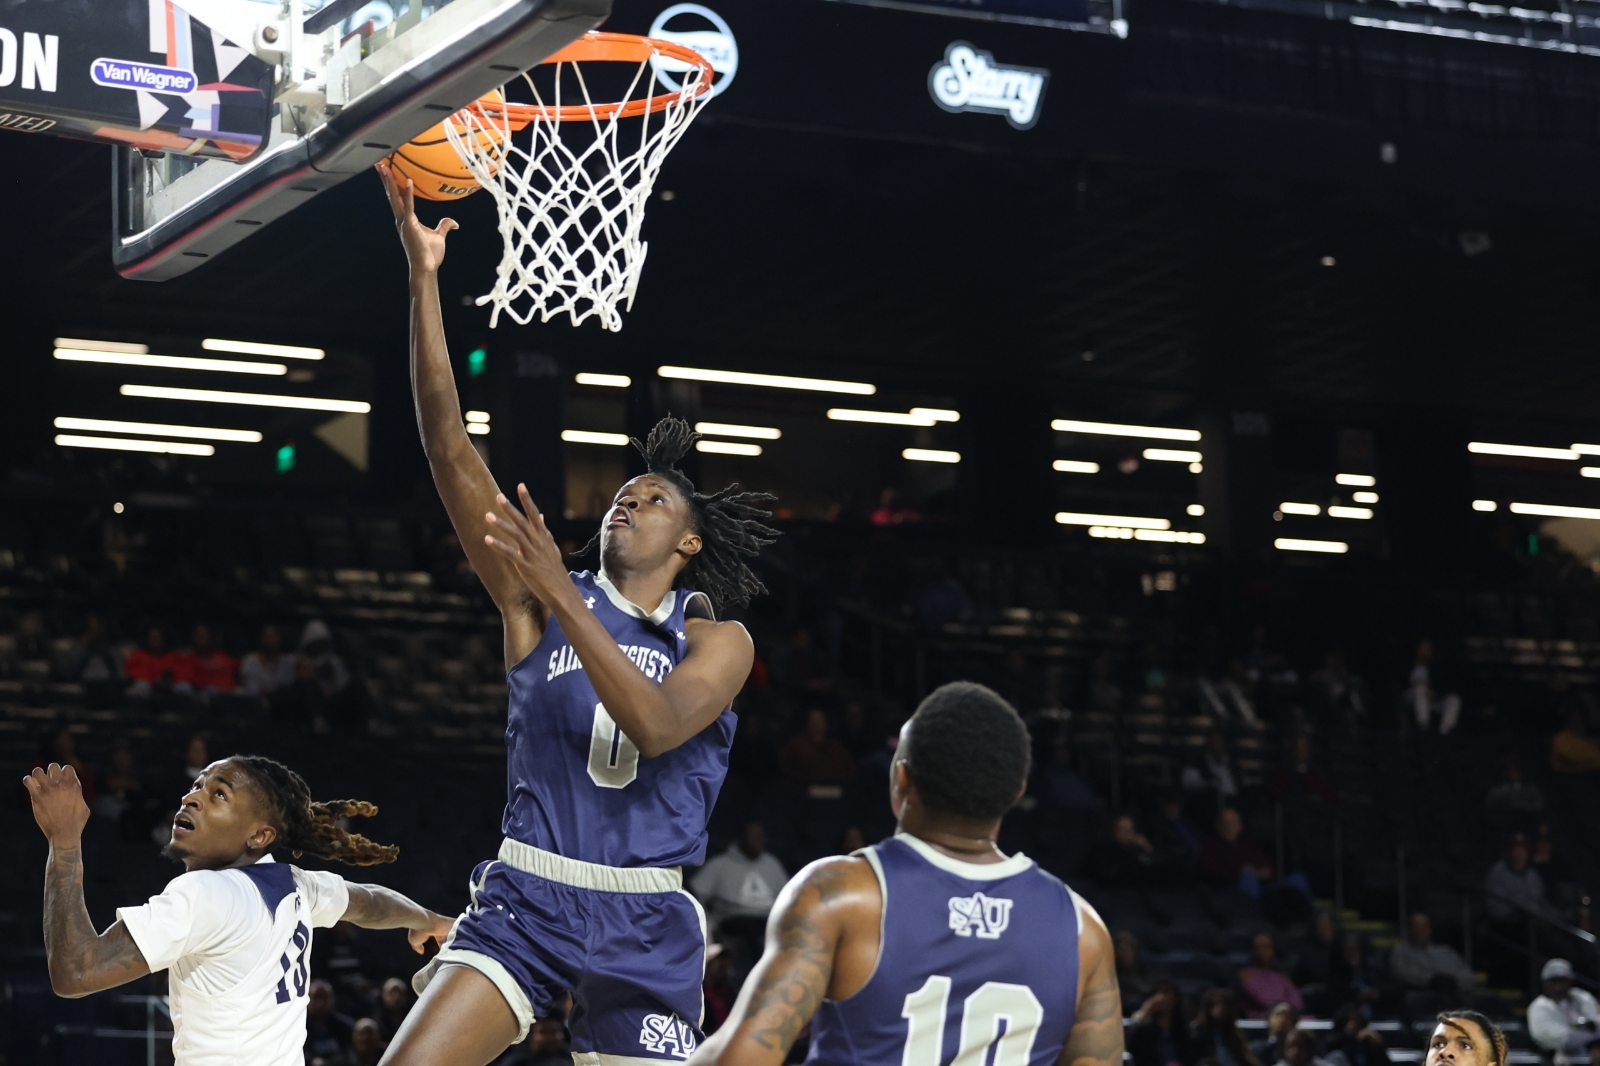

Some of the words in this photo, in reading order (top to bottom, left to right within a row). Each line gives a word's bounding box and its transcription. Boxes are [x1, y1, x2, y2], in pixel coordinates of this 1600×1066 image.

[98, 62, 132, 82] Van
[132, 66, 192, 90] Wagner
[947, 891, 1014, 940] SAU
[639, 1011, 696, 1059] SAU
[901, 974, 1044, 1066] 10
